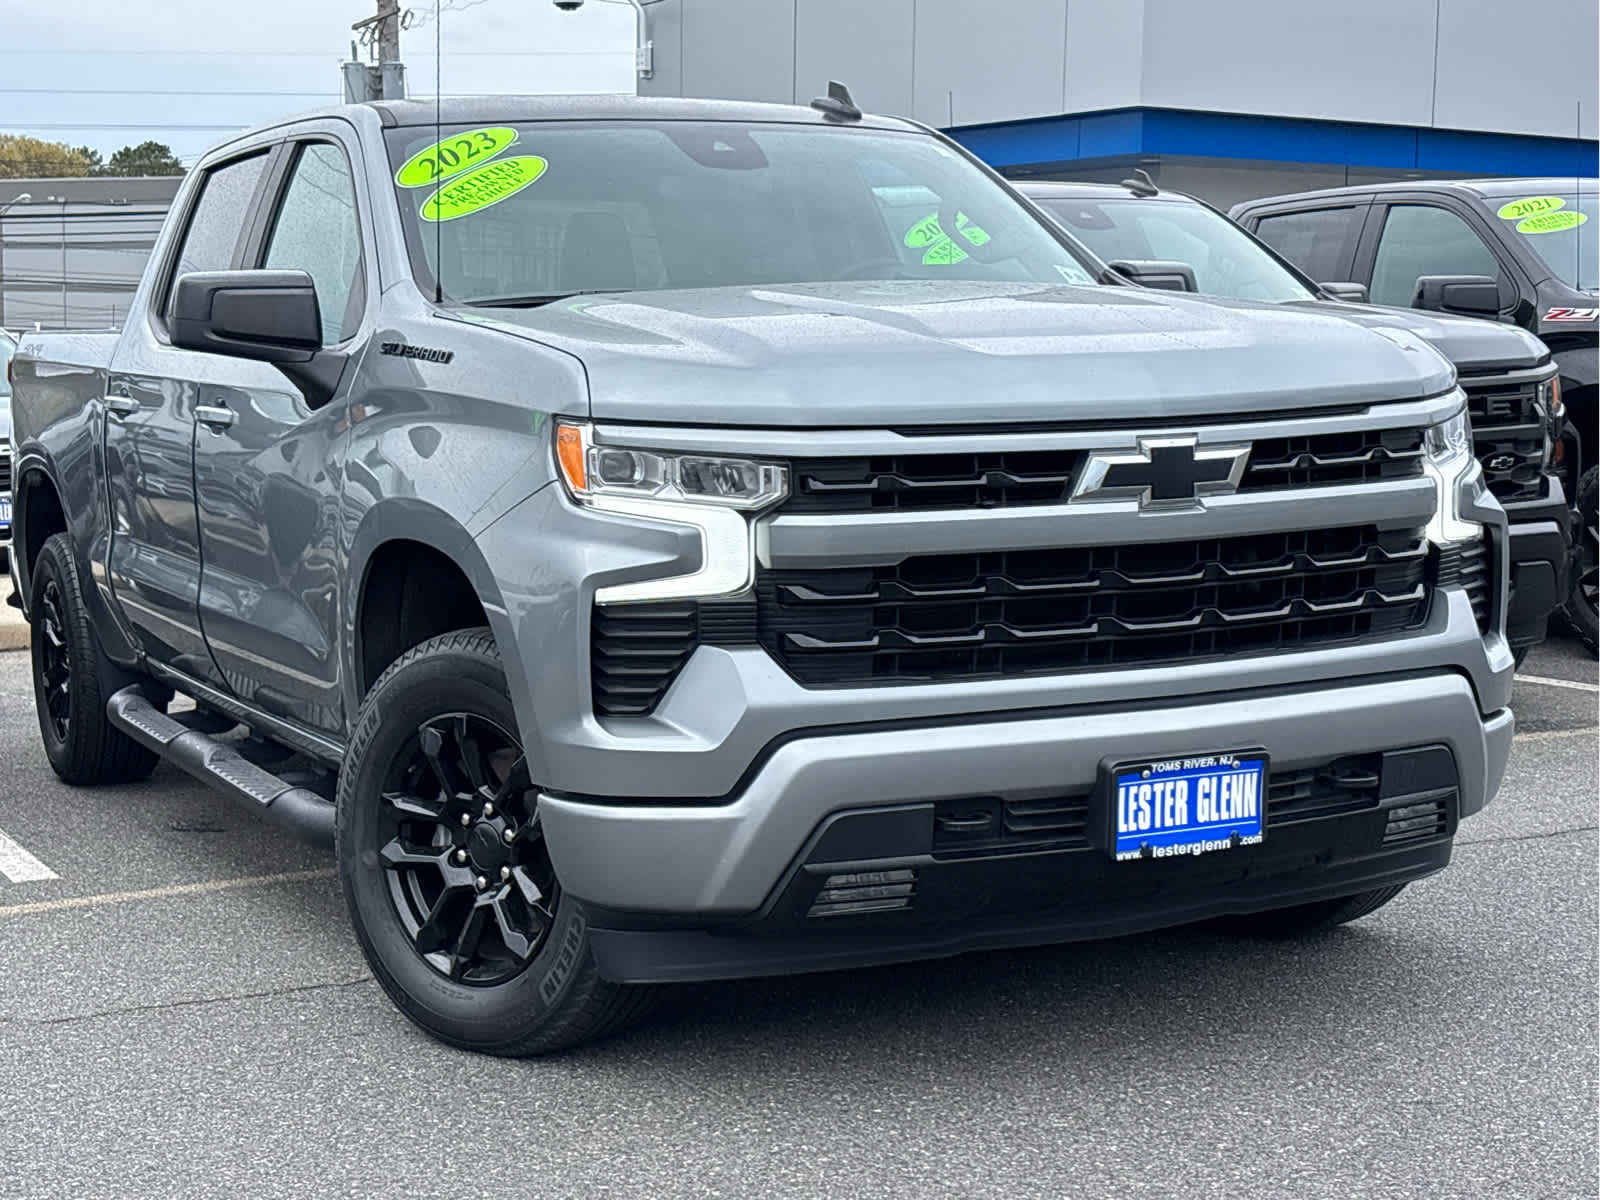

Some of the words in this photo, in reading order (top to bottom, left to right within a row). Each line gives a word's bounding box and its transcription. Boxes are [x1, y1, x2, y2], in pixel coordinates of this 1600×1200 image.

[418, 132, 497, 179] 2023
[433, 160, 520, 206] CERTIFIED
[1511, 198, 1552, 217] 2021
[381, 342, 455, 364] SILVERADO
[1151, 762, 1182, 773] TOMS
[1219, 756, 1233, 766] NJ
[1118, 780, 1189, 833] LESTER
[1197, 772, 1258, 823] GLENN
